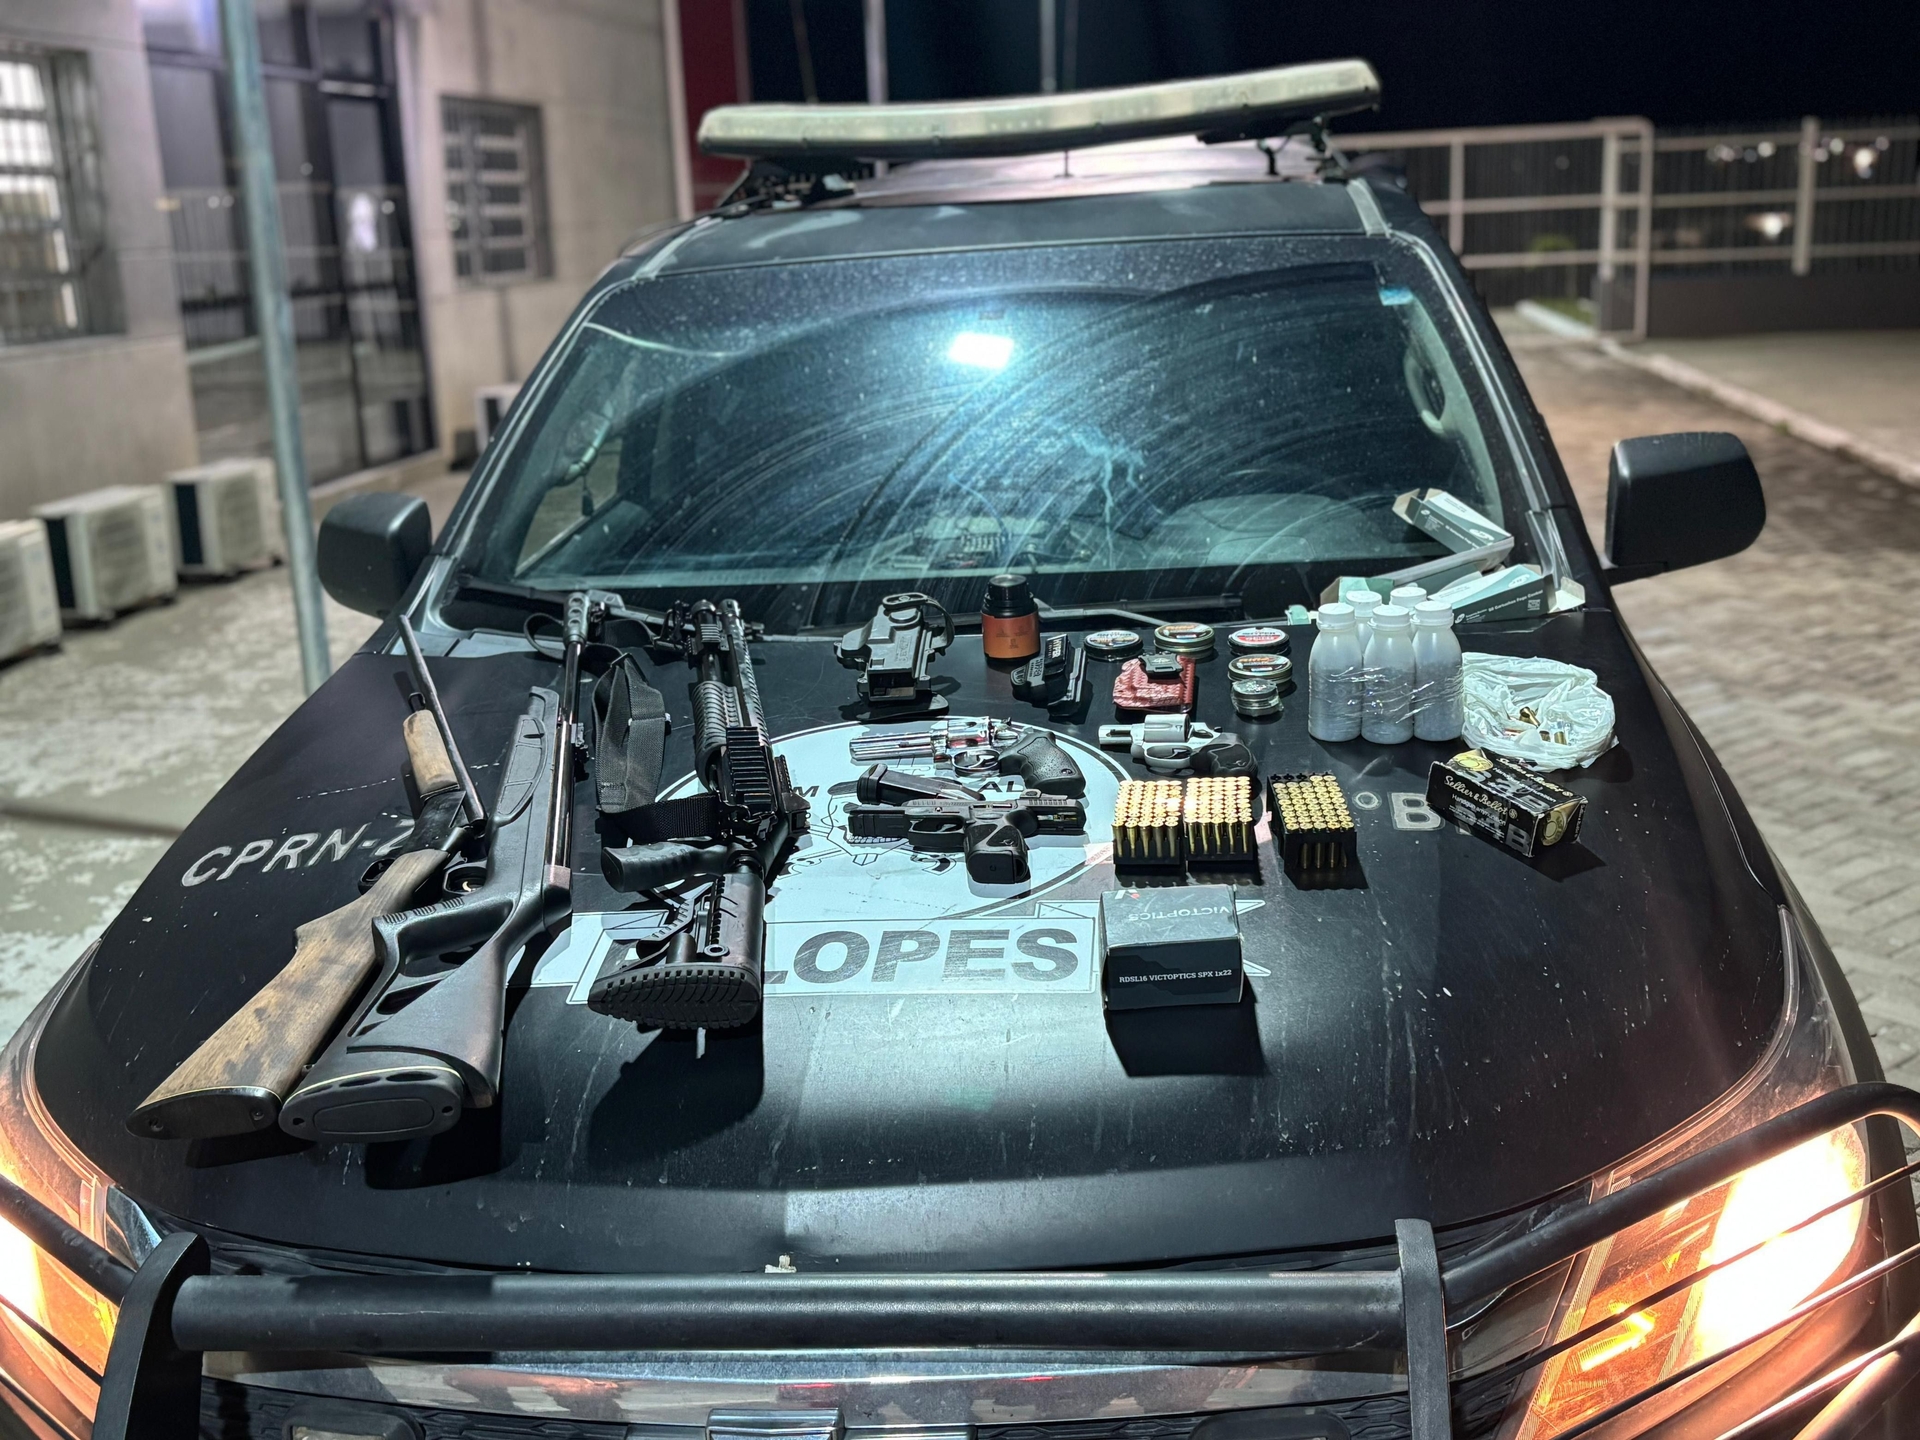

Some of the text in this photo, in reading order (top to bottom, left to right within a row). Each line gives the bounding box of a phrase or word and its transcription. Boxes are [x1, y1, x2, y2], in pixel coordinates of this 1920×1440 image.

[1443, 775, 1509, 816] Sellier & Bellot
[1128, 905, 1231, 922] VICTOPTICS
[596, 927, 1080, 986] OPES
[1119, 969, 1232, 983] RDSL16 VICTOPTICS SPX 1x22
